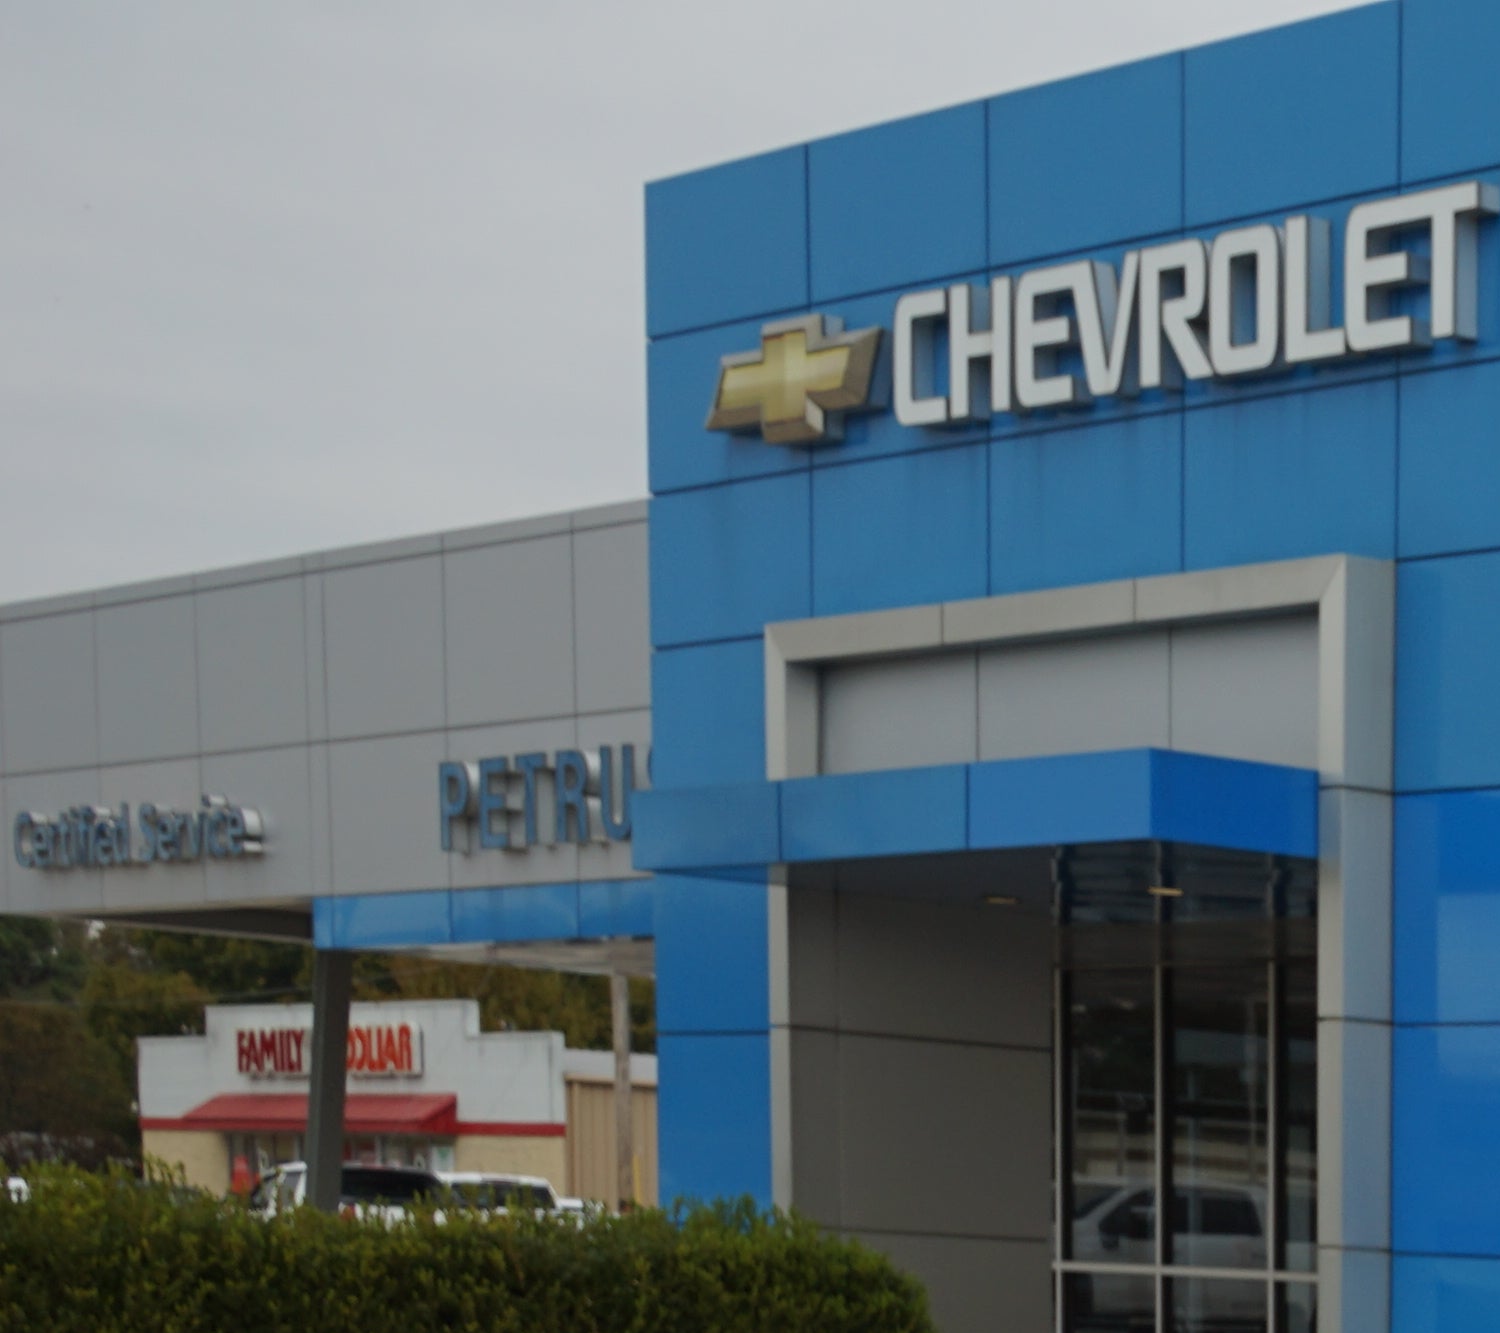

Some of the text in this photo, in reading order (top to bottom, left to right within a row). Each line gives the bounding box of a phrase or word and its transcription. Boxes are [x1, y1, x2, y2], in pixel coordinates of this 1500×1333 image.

[14, 794, 263, 868] Certified Service
[439, 742, 653, 853] PETRU
[236, 1029, 305, 1074] FAMILY
